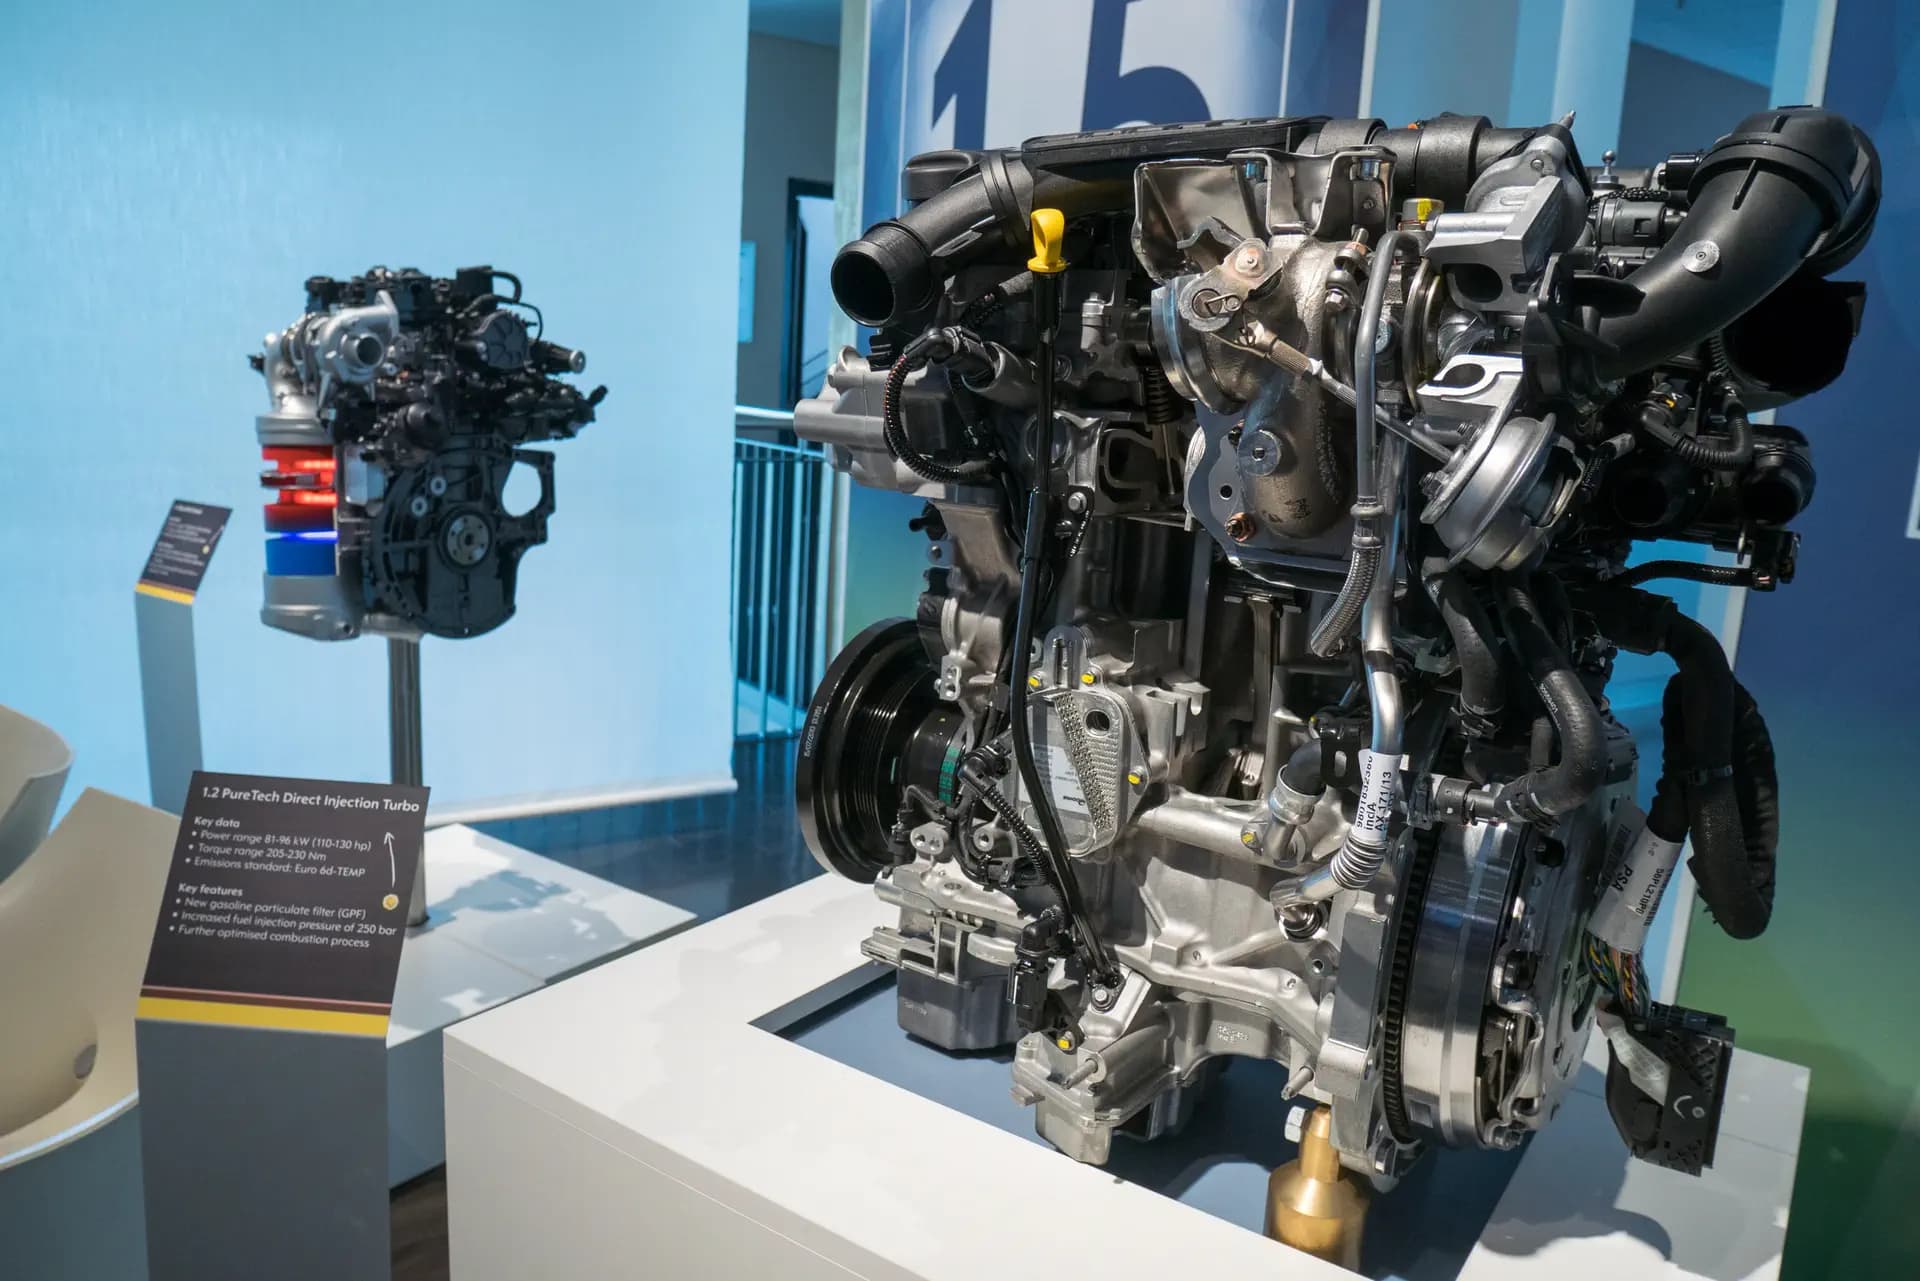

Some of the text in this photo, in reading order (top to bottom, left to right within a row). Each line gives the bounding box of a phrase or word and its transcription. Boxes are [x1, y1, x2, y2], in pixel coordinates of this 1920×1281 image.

[203, 786, 420, 812] 1.2 PureTech Direct Injection Turbo
[1378, 771, 1392, 810] 171/13
[194, 816, 240, 828] Key data
[1374, 815, 1386, 831] AX
[199, 842, 327, 861] Torque range 205-230 Nm
[201, 830, 372, 853] Power range 81-96 kW (110-130 hp)
[194, 856, 366, 877] Emissions standard: Euro 6d-TEMP
[1612, 864, 1634, 892] PSA
[178, 883, 243, 897] Key features
[184, 897, 366, 920] New gasoline particulate filter (GPF)
[181, 911, 397, 936] Increased fuel injection pressure of 250 bar
[178, 924, 370, 948] Further optimised combustion process
